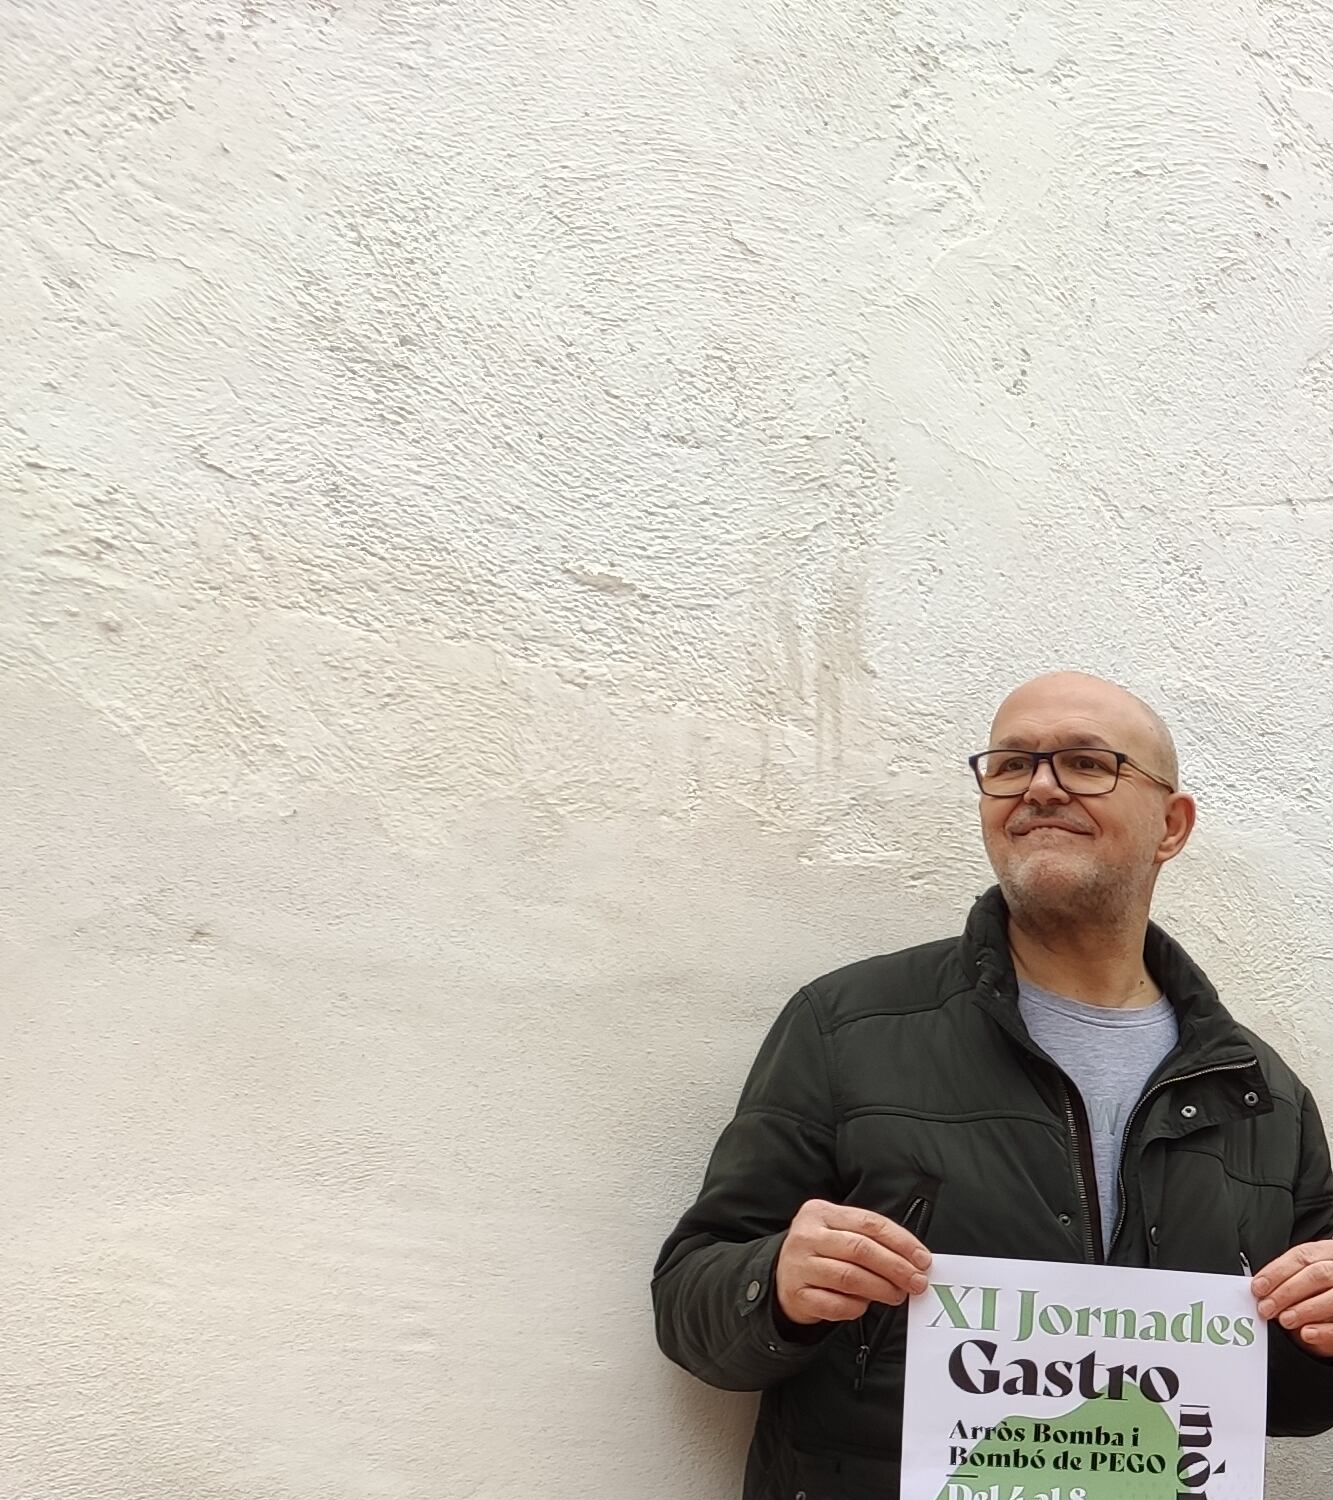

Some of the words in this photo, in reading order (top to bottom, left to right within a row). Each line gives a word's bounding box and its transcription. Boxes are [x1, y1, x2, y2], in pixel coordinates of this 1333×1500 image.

[926, 1284, 1002, 1332] XI
[1012, 1289, 1256, 1346] Jornades
[948, 1339, 1179, 1403] Gastro
[949, 1420, 1025, 1442] Arròs
[1032, 1423, 1124, 1446] Bomba
[1132, 1427, 1139, 1447] i
[950, 1446, 1045, 1469] Bombó
[1052, 1450, 1082, 1470] de
[1089, 1451, 1165, 1474] PEGO
